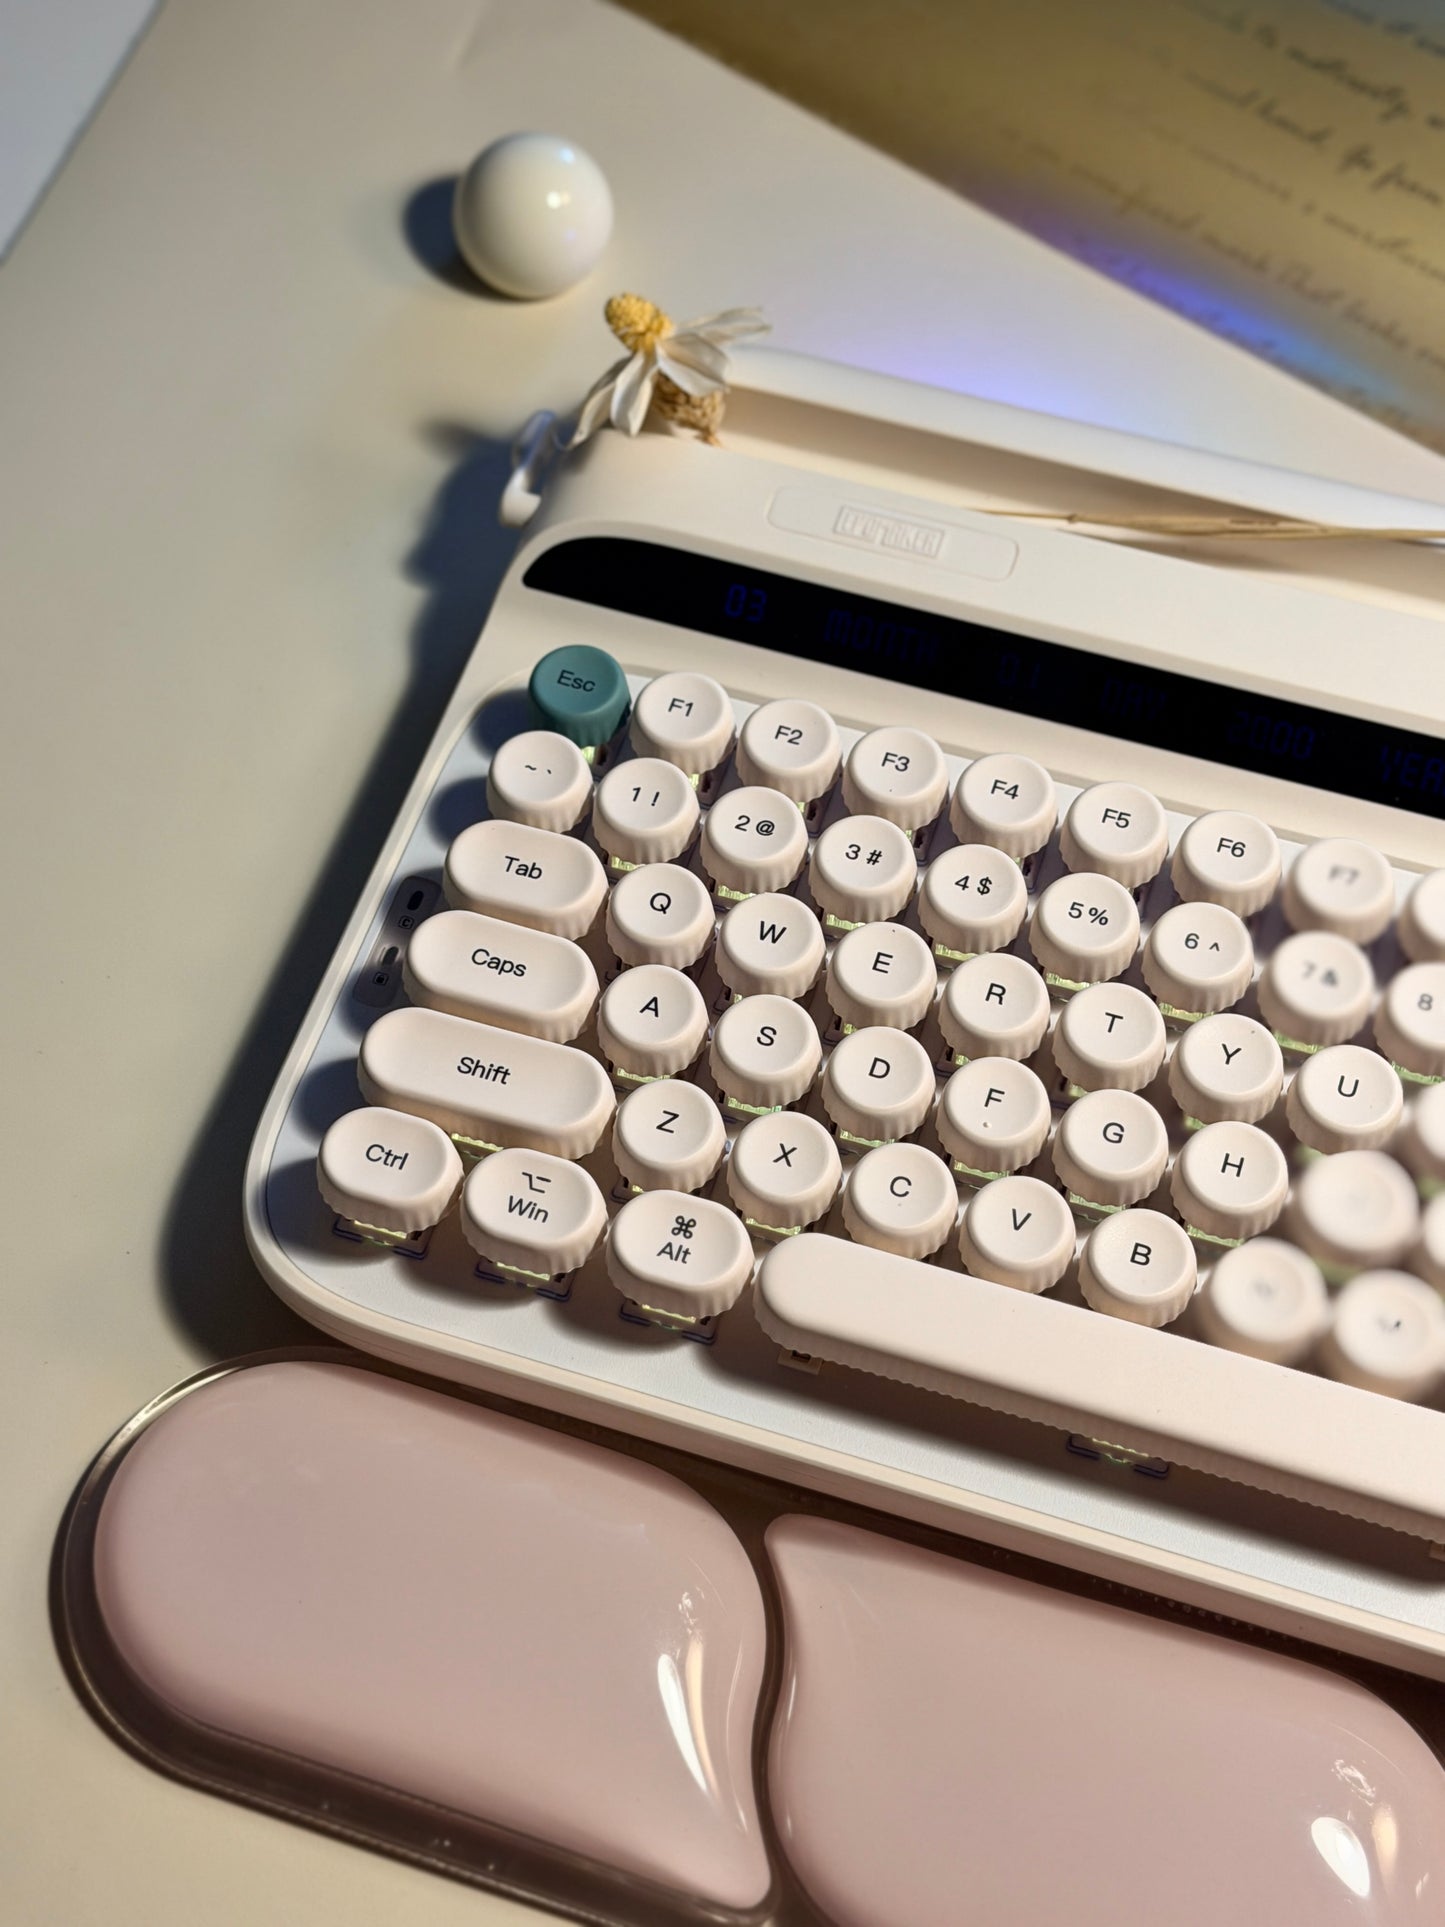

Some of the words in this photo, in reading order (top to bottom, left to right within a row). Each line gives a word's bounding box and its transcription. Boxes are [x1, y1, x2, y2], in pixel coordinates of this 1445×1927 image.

[556, 669, 596, 693] Esc
[724, 582, 767, 624] 03
[1380, 744, 1445, 797] YEA
[668, 697, 694, 717] F1
[774, 724, 803, 746] F2
[881, 751, 910, 772] F3
[632, 786, 642, 802] 1
[650, 791, 660, 807] !
[990, 779, 1019, 800] F4
[734, 814, 751, 832] 2
[755, 819, 775, 837] @
[1101, 807, 1132, 829] F5
[845, 843, 861, 861] 3
[866, 849, 883, 866] #
[1216, 837, 1246, 858] F6
[504, 855, 543, 880] Tab
[954, 875, 970, 891] 4
[976, 876, 993, 896] $
[649, 892, 672, 915] Q
[1068, 901, 1085, 919] 5
[1088, 907, 1109, 926] %
[759, 920, 787, 944] W
[1184, 932, 1200, 950] 6
[471, 948, 527, 977] Caps
[871, 951, 894, 974] E
[985, 982, 1007, 1006] R
[1417, 993, 1434, 1012] 8
[639, 996, 659, 1018] A
[1104, 1012, 1124, 1033] T
[756, 1026, 777, 1047] S
[1221, 1043, 1242, 1065] Y
[456, 1056, 511, 1085] Shift
[868, 1056, 891, 1079] D
[984, 1087, 1006, 1108] F
[1337, 1075, 1360, 1098] U
[655, 1110, 680, 1134] Z
[1102, 1122, 1125, 1144] G
[365, 1143, 409, 1171] Ctrl
[772, 1143, 798, 1168] X
[1220, 1152, 1245, 1178] H
[889, 1175, 912, 1198] C
[508, 1195, 549, 1224] Win
[1011, 1208, 1032, 1231] V
[656, 1241, 692, 1265] Alt
[1129, 1242, 1152, 1266] B
